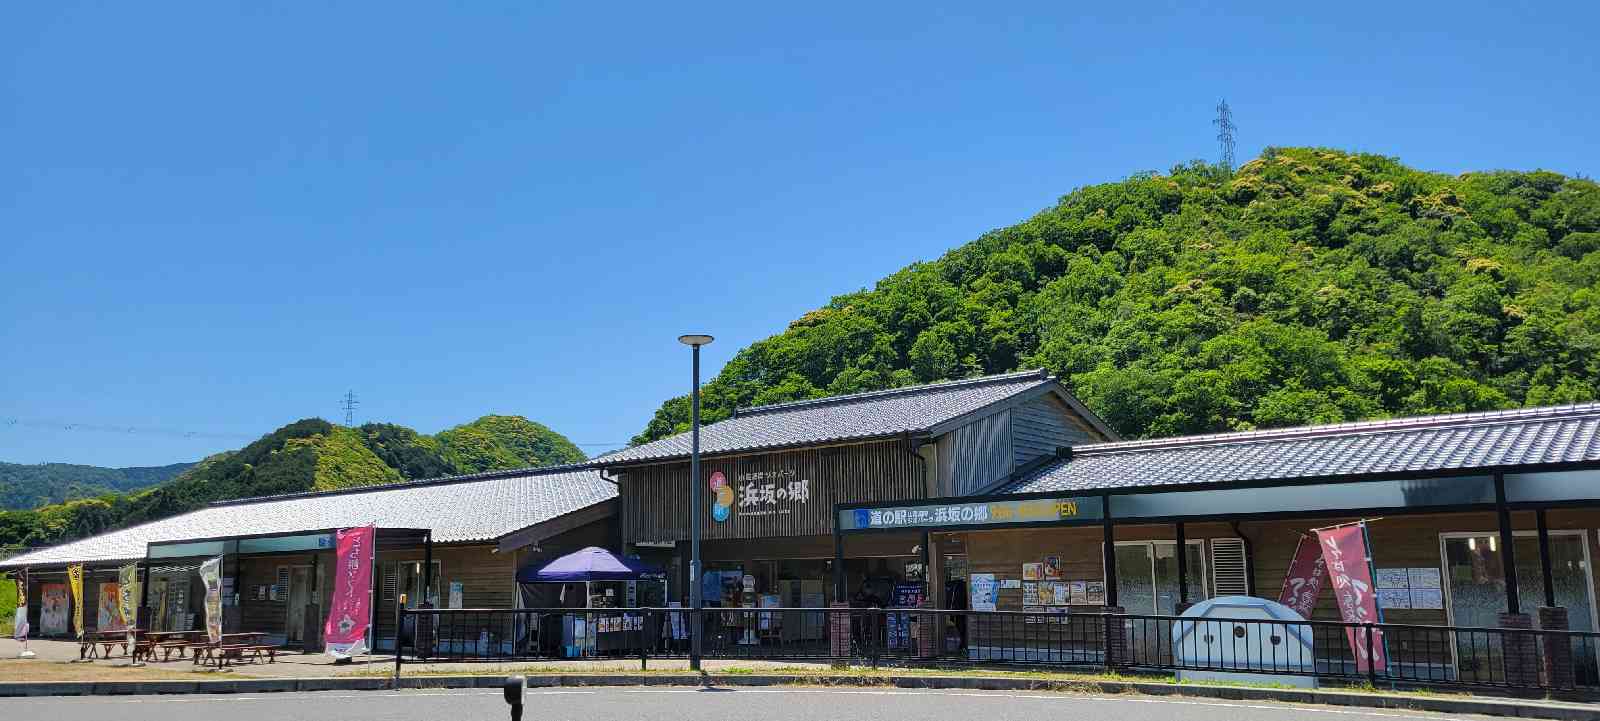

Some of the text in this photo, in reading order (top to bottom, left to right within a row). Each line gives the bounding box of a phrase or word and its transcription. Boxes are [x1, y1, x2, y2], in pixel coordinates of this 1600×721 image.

[738, 479, 809, 507] 浜坂の郷
[870, 509, 907, 526] 道の駅
[934, 503, 988, 522] 浜坂の郷
